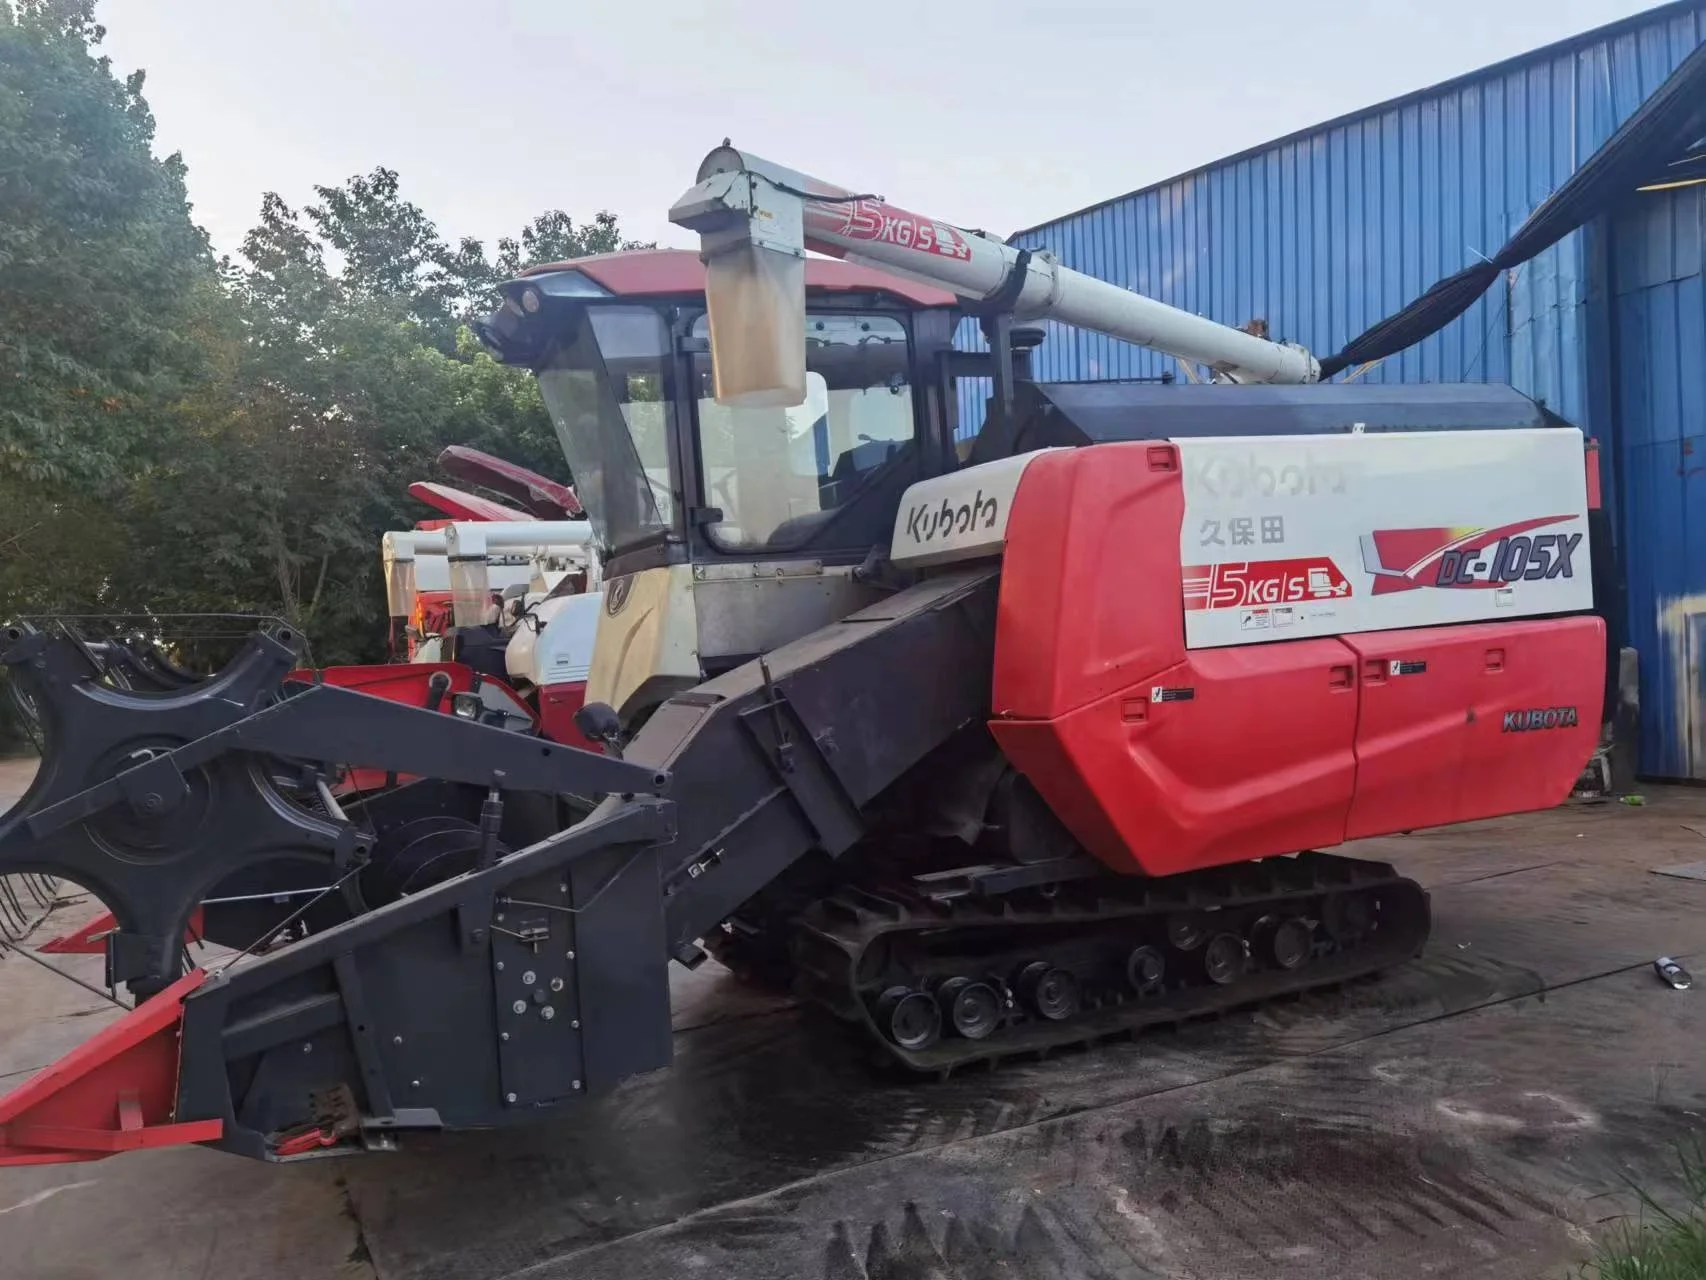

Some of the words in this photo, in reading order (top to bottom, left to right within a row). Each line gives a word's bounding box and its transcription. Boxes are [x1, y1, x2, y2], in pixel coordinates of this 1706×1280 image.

[907, 489, 998, 543] Kubota
[1200, 516, 1285, 547] 久保田
[1436, 533, 1583, 586] DC-105X
[1502, 706, 1577, 732] KUBOTA
